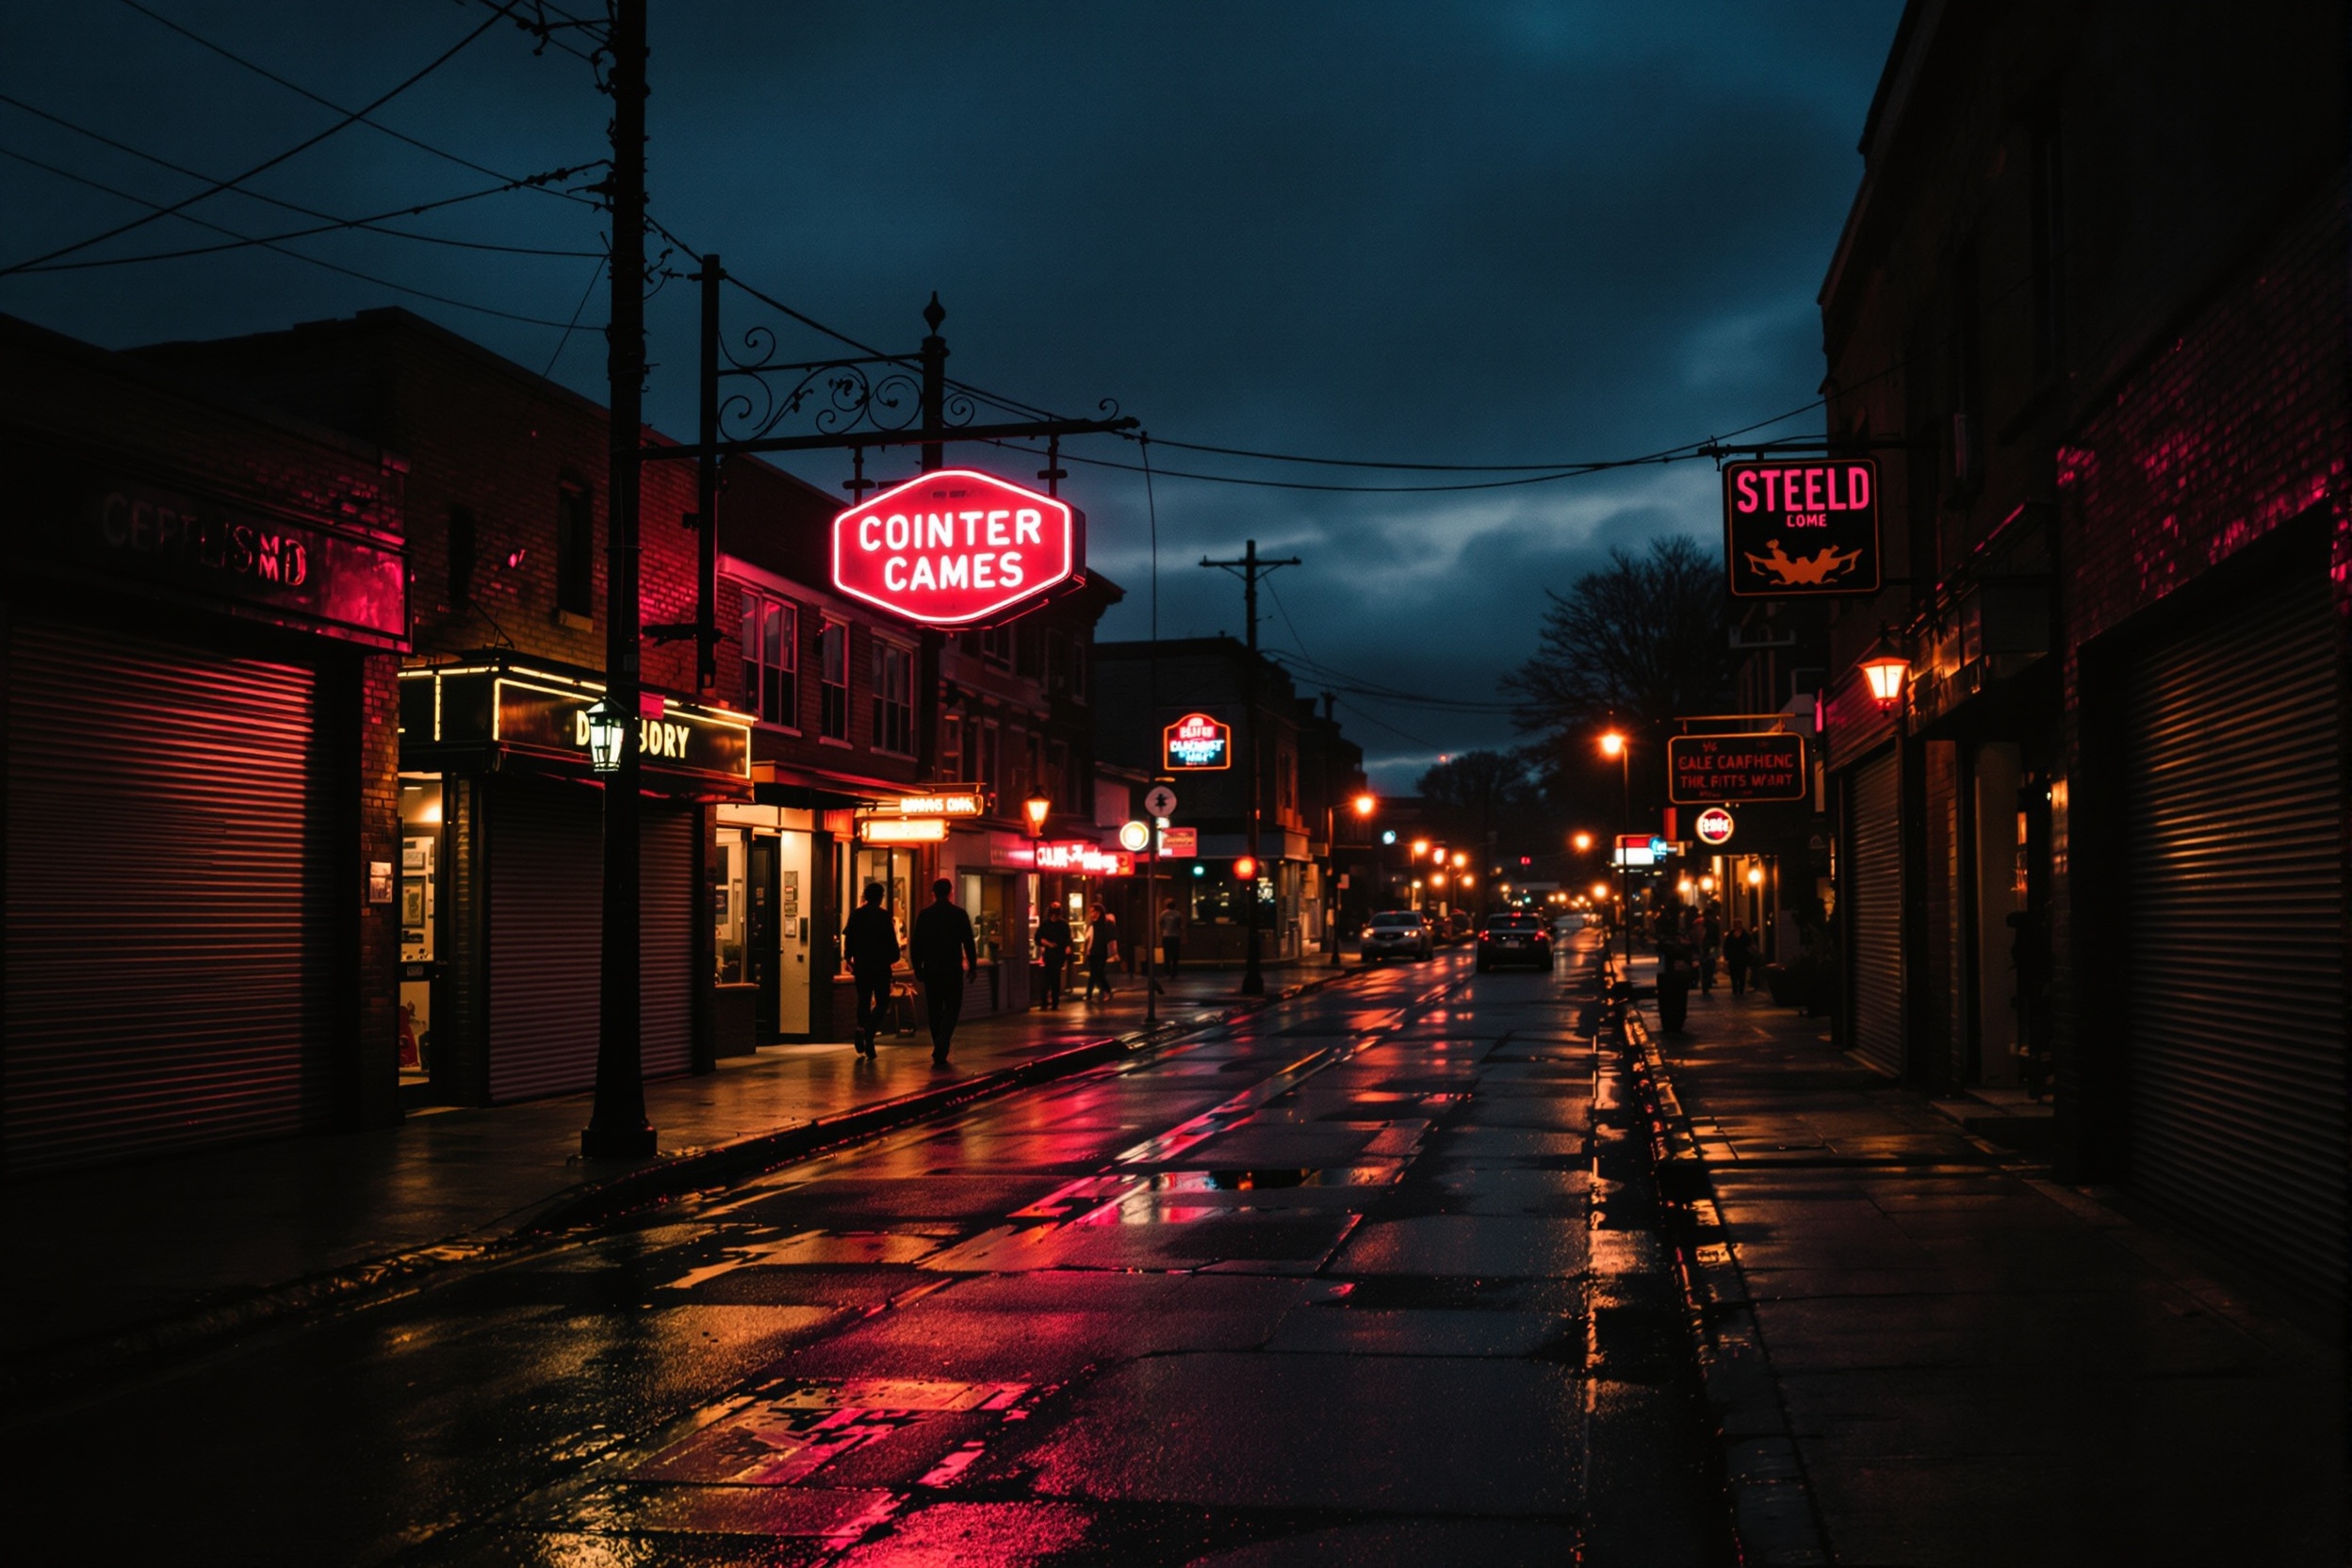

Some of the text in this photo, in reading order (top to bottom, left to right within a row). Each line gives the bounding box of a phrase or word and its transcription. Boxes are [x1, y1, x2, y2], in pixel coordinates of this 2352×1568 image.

[1737, 466, 1870, 514] STEELD
[858, 508, 1042, 552] COINTER
[884, 551, 1024, 592] CAMES
